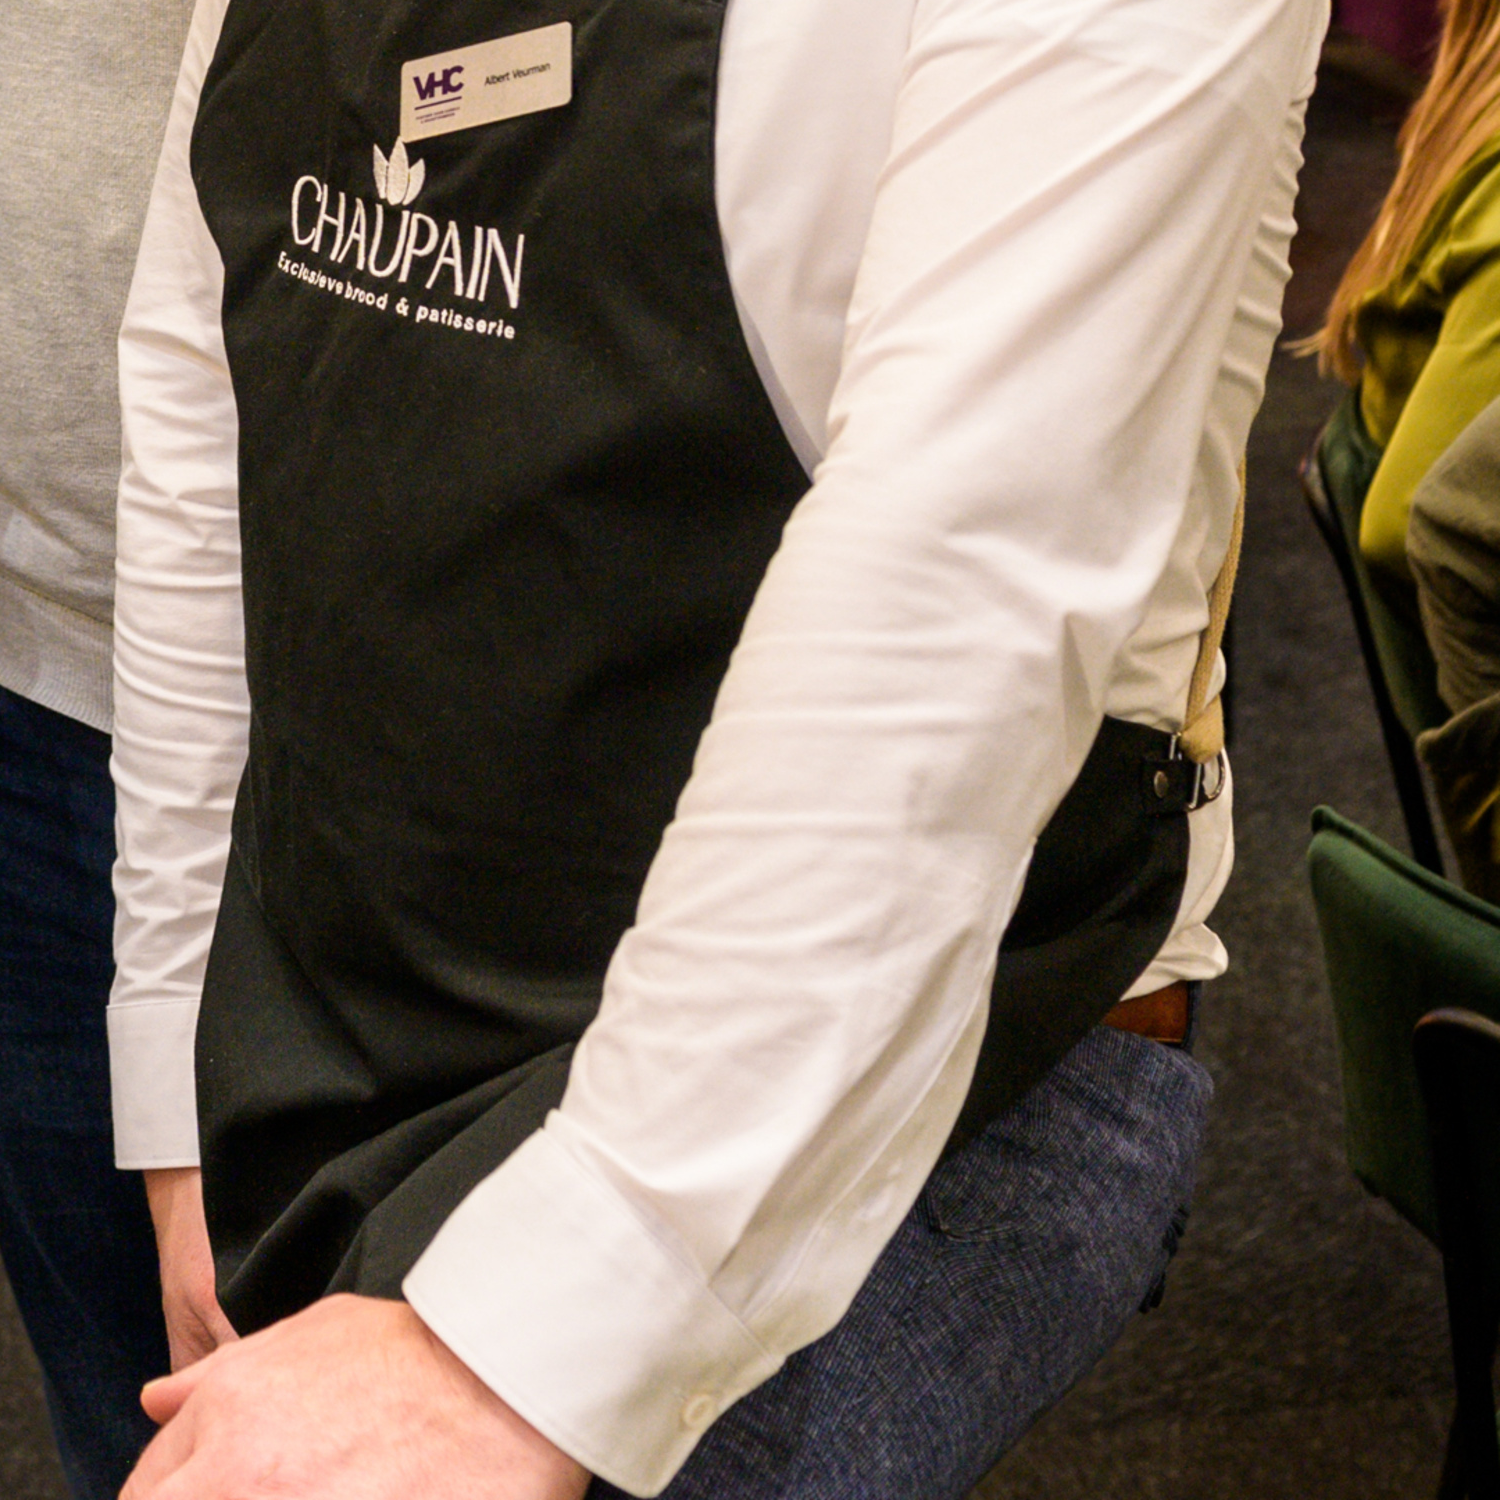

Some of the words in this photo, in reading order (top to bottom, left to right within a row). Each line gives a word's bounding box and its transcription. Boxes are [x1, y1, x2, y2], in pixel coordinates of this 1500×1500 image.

[413, 65, 464, 101] VHC
[484, 71, 510, 87] Albert
[291, 174, 525, 309] CHAUPAIN
[395, 297, 411, 317] &
[415, 304, 516, 340] patisserie
